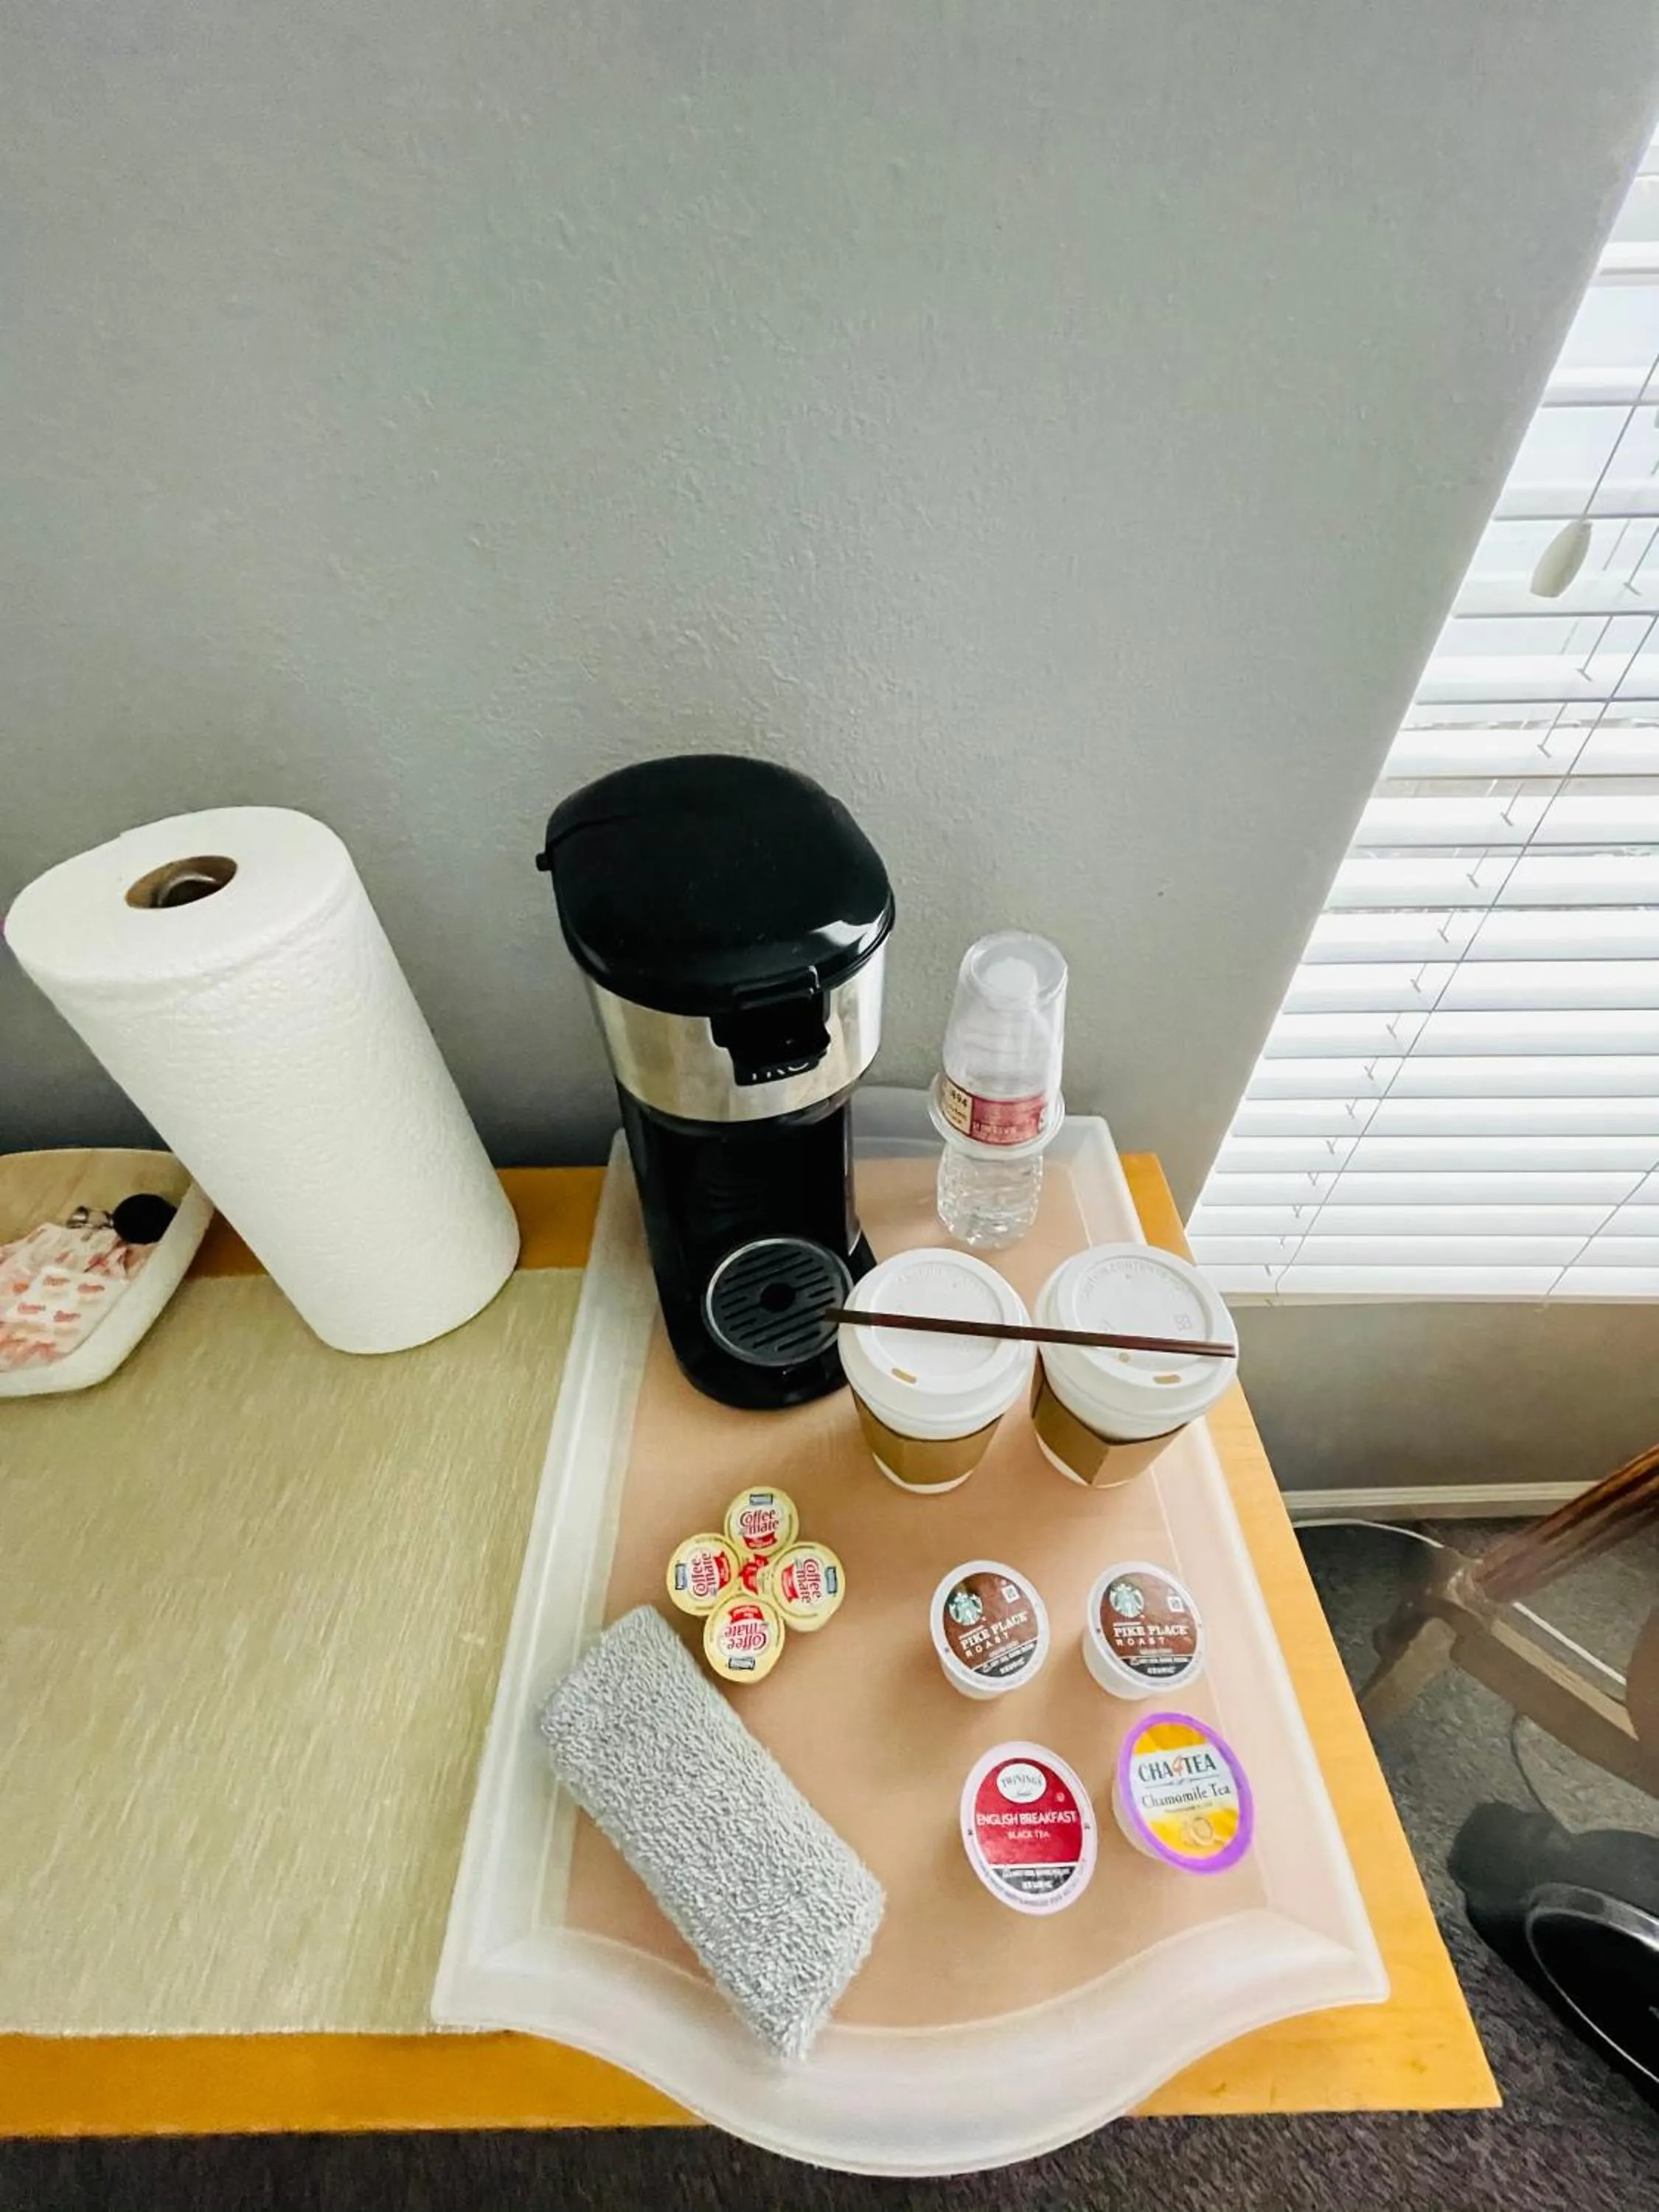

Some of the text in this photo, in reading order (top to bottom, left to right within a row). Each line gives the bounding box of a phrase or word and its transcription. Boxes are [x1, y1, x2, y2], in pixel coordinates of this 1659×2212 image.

[740, 1509, 776, 1528] Coffee
[748, 1520, 779, 1535] mate
[691, 1557, 709, 1598] Coffee
[701, 1552, 716, 1591] mate
[804, 1558, 822, 1599] Coffee
[796, 1568, 812, 1604] mate
[960, 1629, 990, 1650] PIKE
[991, 1611, 1028, 1635] PLACE
[1113, 1626, 1145, 1638] PIKE
[727, 1632, 767, 1652] Coffee
[1142, 1786, 1208, 1807] Chamomile
[1210, 1783, 1231, 1797] Tea
[976, 1810, 1077, 1826] ENGLISH BREAKFAST
[1007, 1829, 1033, 1840] BLACK
